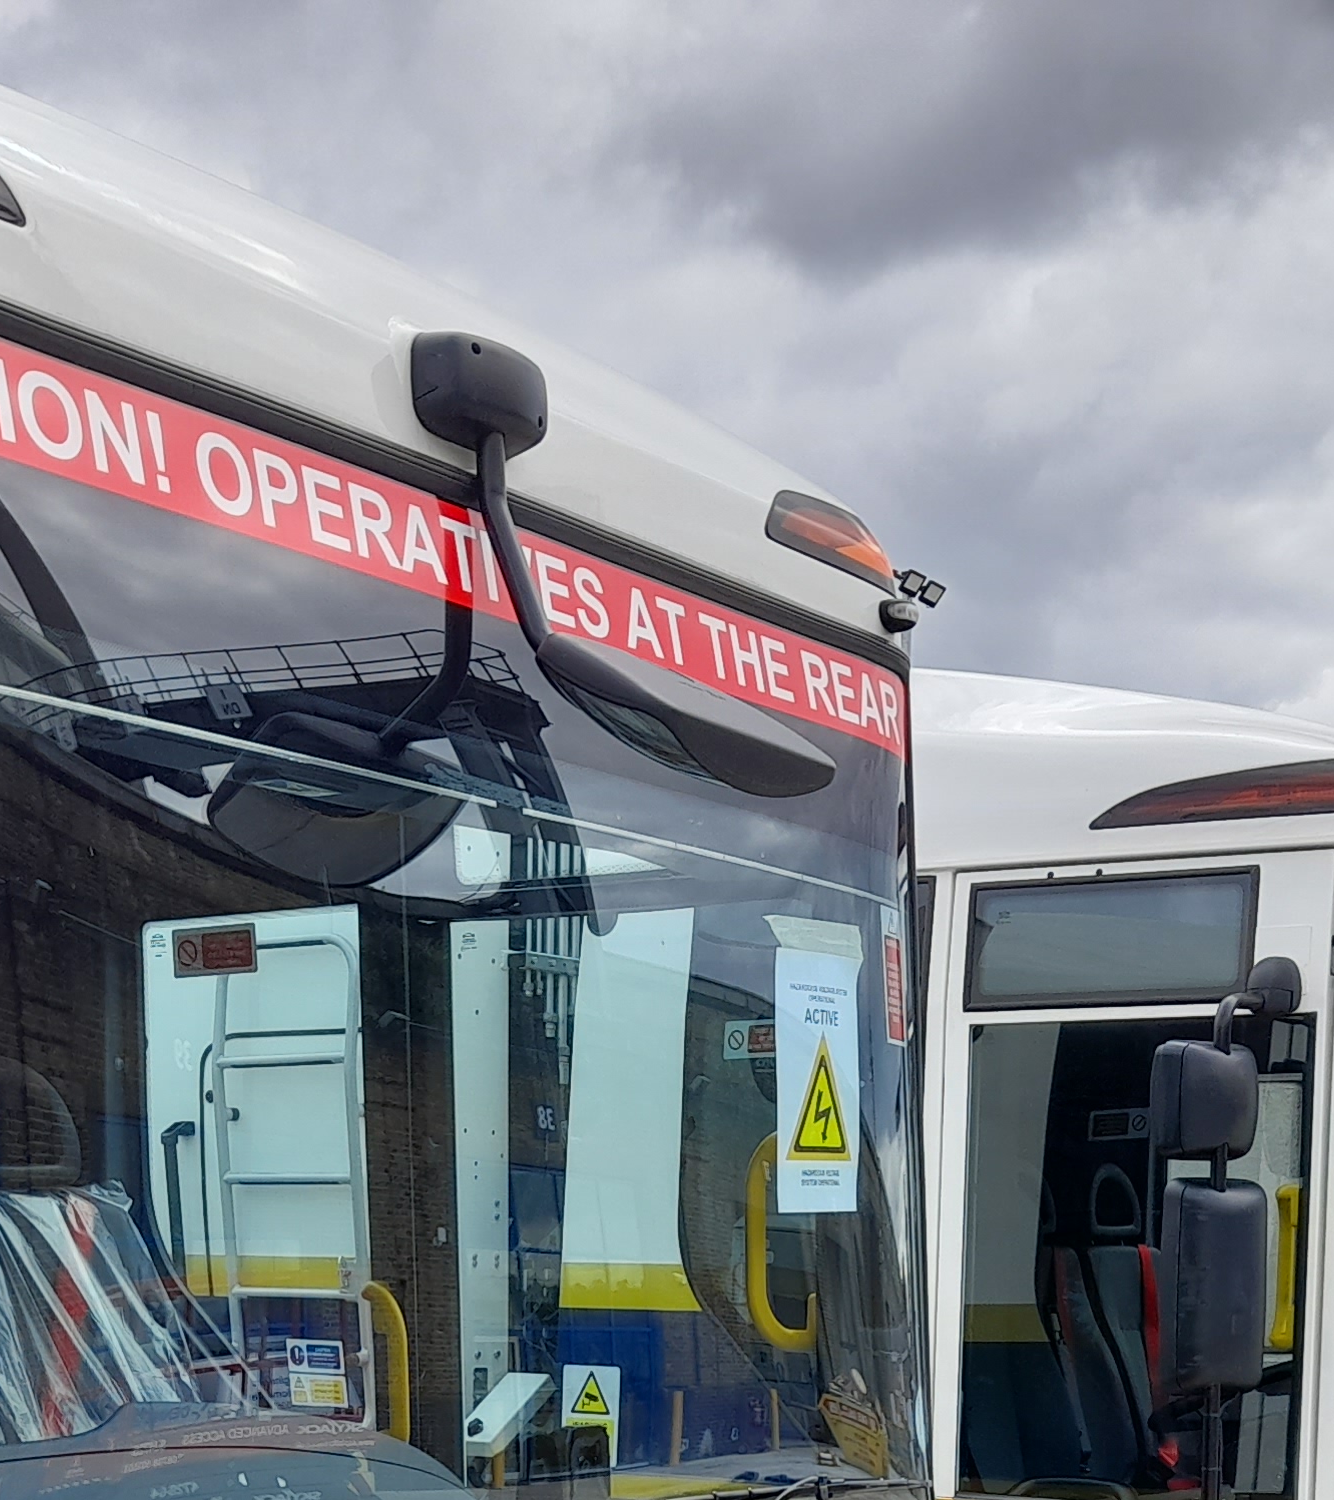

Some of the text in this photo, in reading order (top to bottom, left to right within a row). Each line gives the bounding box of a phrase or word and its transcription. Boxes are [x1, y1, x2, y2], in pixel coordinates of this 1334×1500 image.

[195, 431, 610, 640] OPERATIES
[627, 587, 685, 665] AT
[698, 612, 796, 703] THE
[800, 650, 901, 745] REAR
[804, 1008, 840, 1027] ACTIVE
